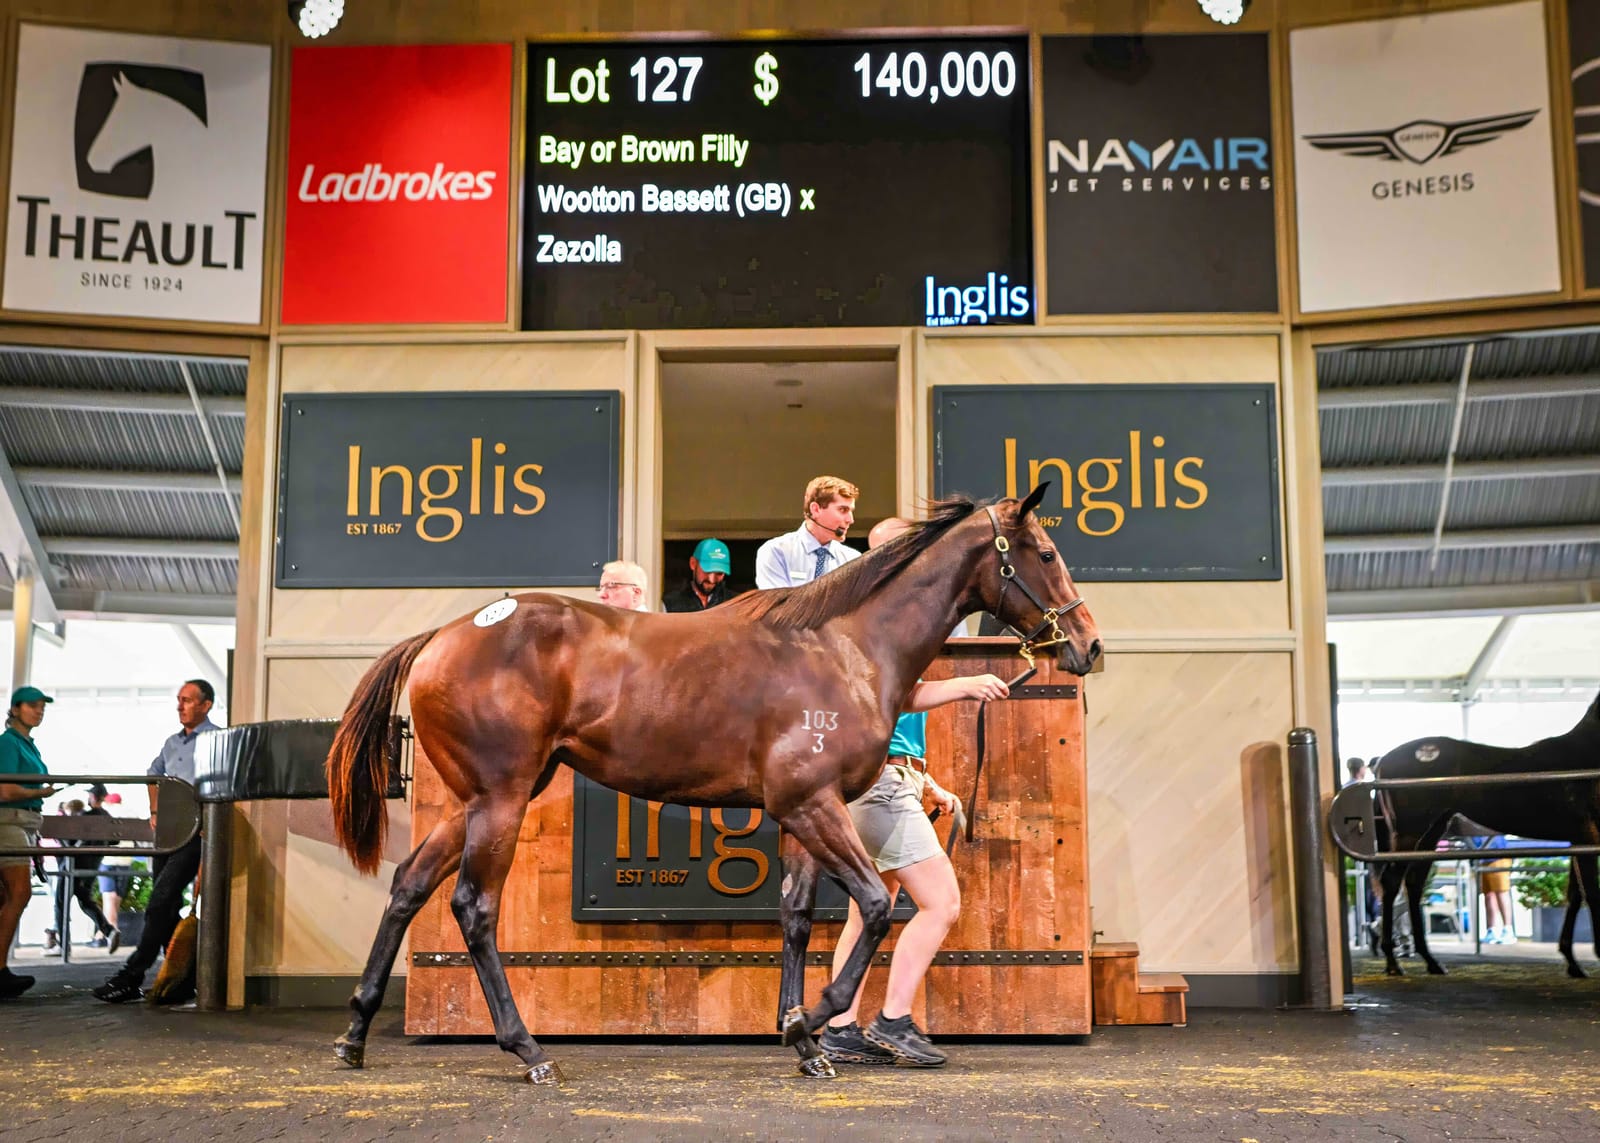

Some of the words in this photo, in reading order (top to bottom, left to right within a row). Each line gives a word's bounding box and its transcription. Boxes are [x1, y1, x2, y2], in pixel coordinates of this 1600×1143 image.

[546, 58, 610, 103] Lot
[630, 56, 704, 103] 127
[753, 51, 779, 106] $
[854, 51, 1016, 104] 140,000
[539, 135, 586, 169] Bay
[590, 141, 615, 162] or
[621, 135, 695, 163] Brown
[701, 134, 749, 168] Filly
[1048, 138, 1269, 173] NAVAIR
[298, 162, 497, 203] Ladbrokes
[1049, 178, 1099, 193] JET
[1122, 176, 1271, 193] SERVICES
[1371, 172, 1475, 200] GENESIS
[537, 185, 636, 213] Wootton
[641, 184, 731, 213] Bassett
[735, 183, 792, 218] (GB)
[799, 188, 816, 210] x
[16, 195, 257, 271] THEAULT
[80, 272, 132, 289] SINCE
[143, 276, 183, 292] 1924
[925, 271, 1030, 325] Inglis
[346, 437, 546, 542] Inglis
[1004, 430, 1208, 536] Inglis
[346, 523, 369, 535] EST
[372, 523, 402, 535] 1867
[1039, 516, 1062, 527] 867
[801, 709, 839, 731] 103
[812, 732, 825, 753] 3
[616, 869, 645, 884] EST
[649, 869, 689, 884] 1867
